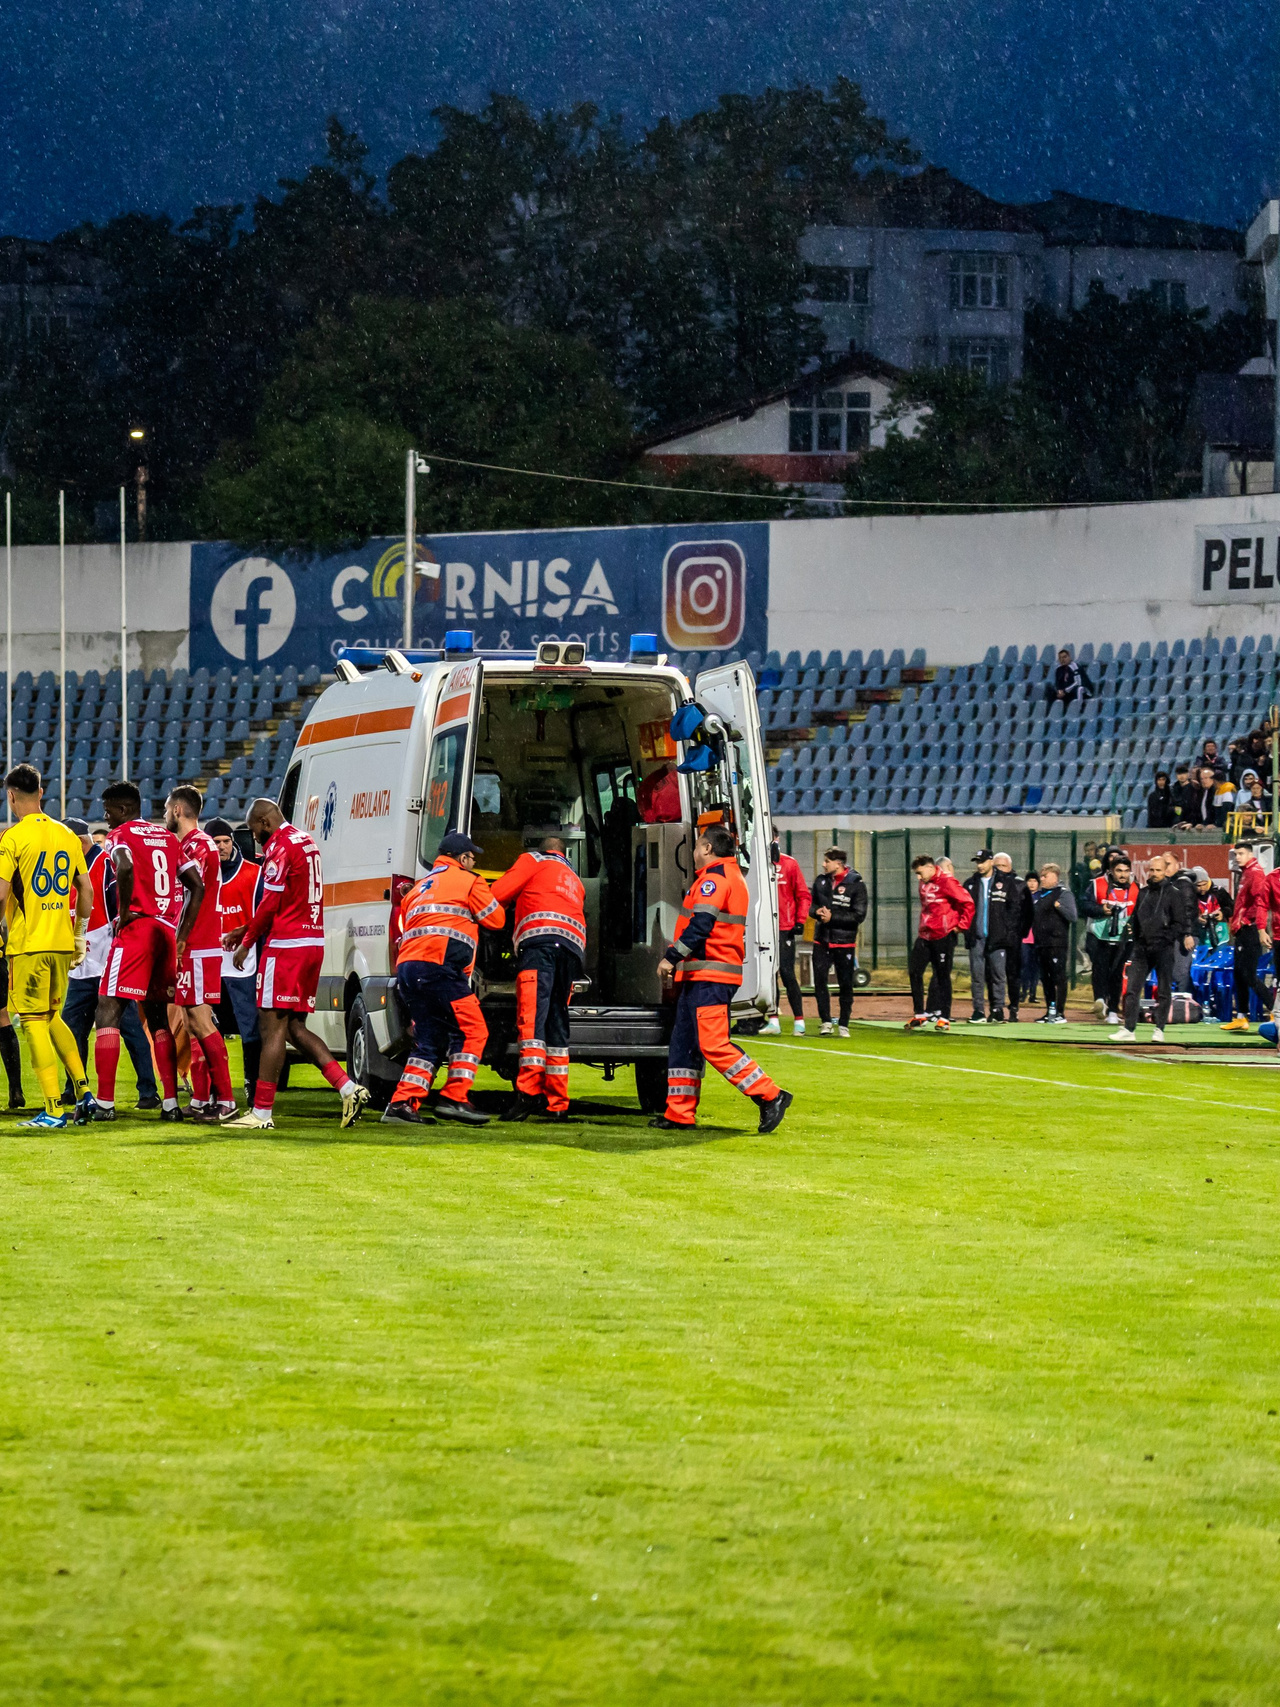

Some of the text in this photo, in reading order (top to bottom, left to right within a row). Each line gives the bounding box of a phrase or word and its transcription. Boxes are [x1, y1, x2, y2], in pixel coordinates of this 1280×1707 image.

[31, 850, 71, 898] 68
[151, 849, 170, 897] 8
[306, 853, 323, 904] 19
[176, 971, 192, 989] 24
